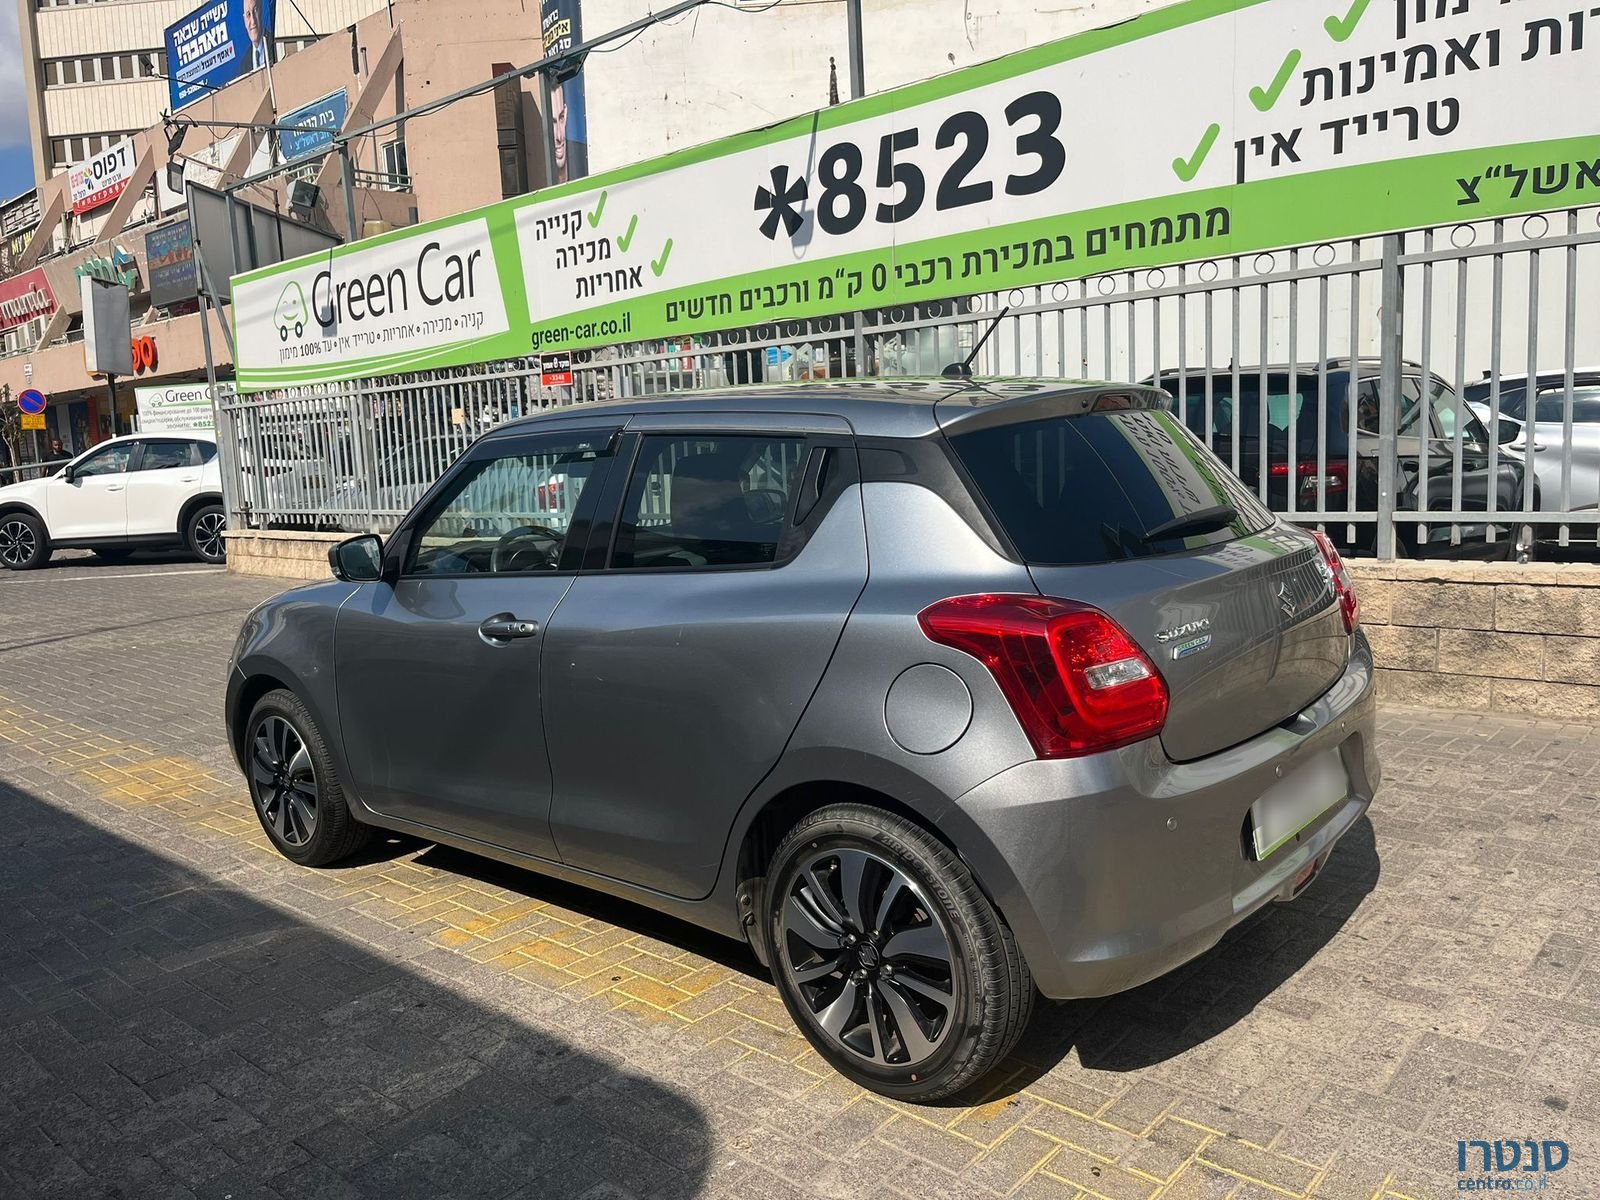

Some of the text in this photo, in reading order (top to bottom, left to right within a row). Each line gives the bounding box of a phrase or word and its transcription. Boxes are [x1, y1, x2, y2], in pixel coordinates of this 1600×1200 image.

[173, 1, 228, 47] עשייה שבאה
[177, 21, 228, 67] מאהבה!
[1300, 28, 1500, 106] ואמינות
[1234, 97, 1461, 185] טרייד אין
[93, 147, 125, 180] דפוס
[535, 209, 583, 241] קנייה
[1085, 206, 1231, 257] מתמחים
[556, 237, 612, 270] מכירה
[960, 233, 1075, 278] במכירת
[312, 242, 481, 328] Green Car
[575, 265, 643, 299] אחריות
[872, 262, 887, 292] 0
[894, 256, 952, 288] רכבי
[666, 293, 732, 322] חדשים
[740, 280, 809, 312] ורכבים
[279, 311, 484, 364] קניה מכירה אחריות טרייד אין עד 100% מימון
[531, 312, 631, 350] green-car.co.il
[165, 389, 203, 403] Green
[1155, 618, 1210, 643] SUZUKI
